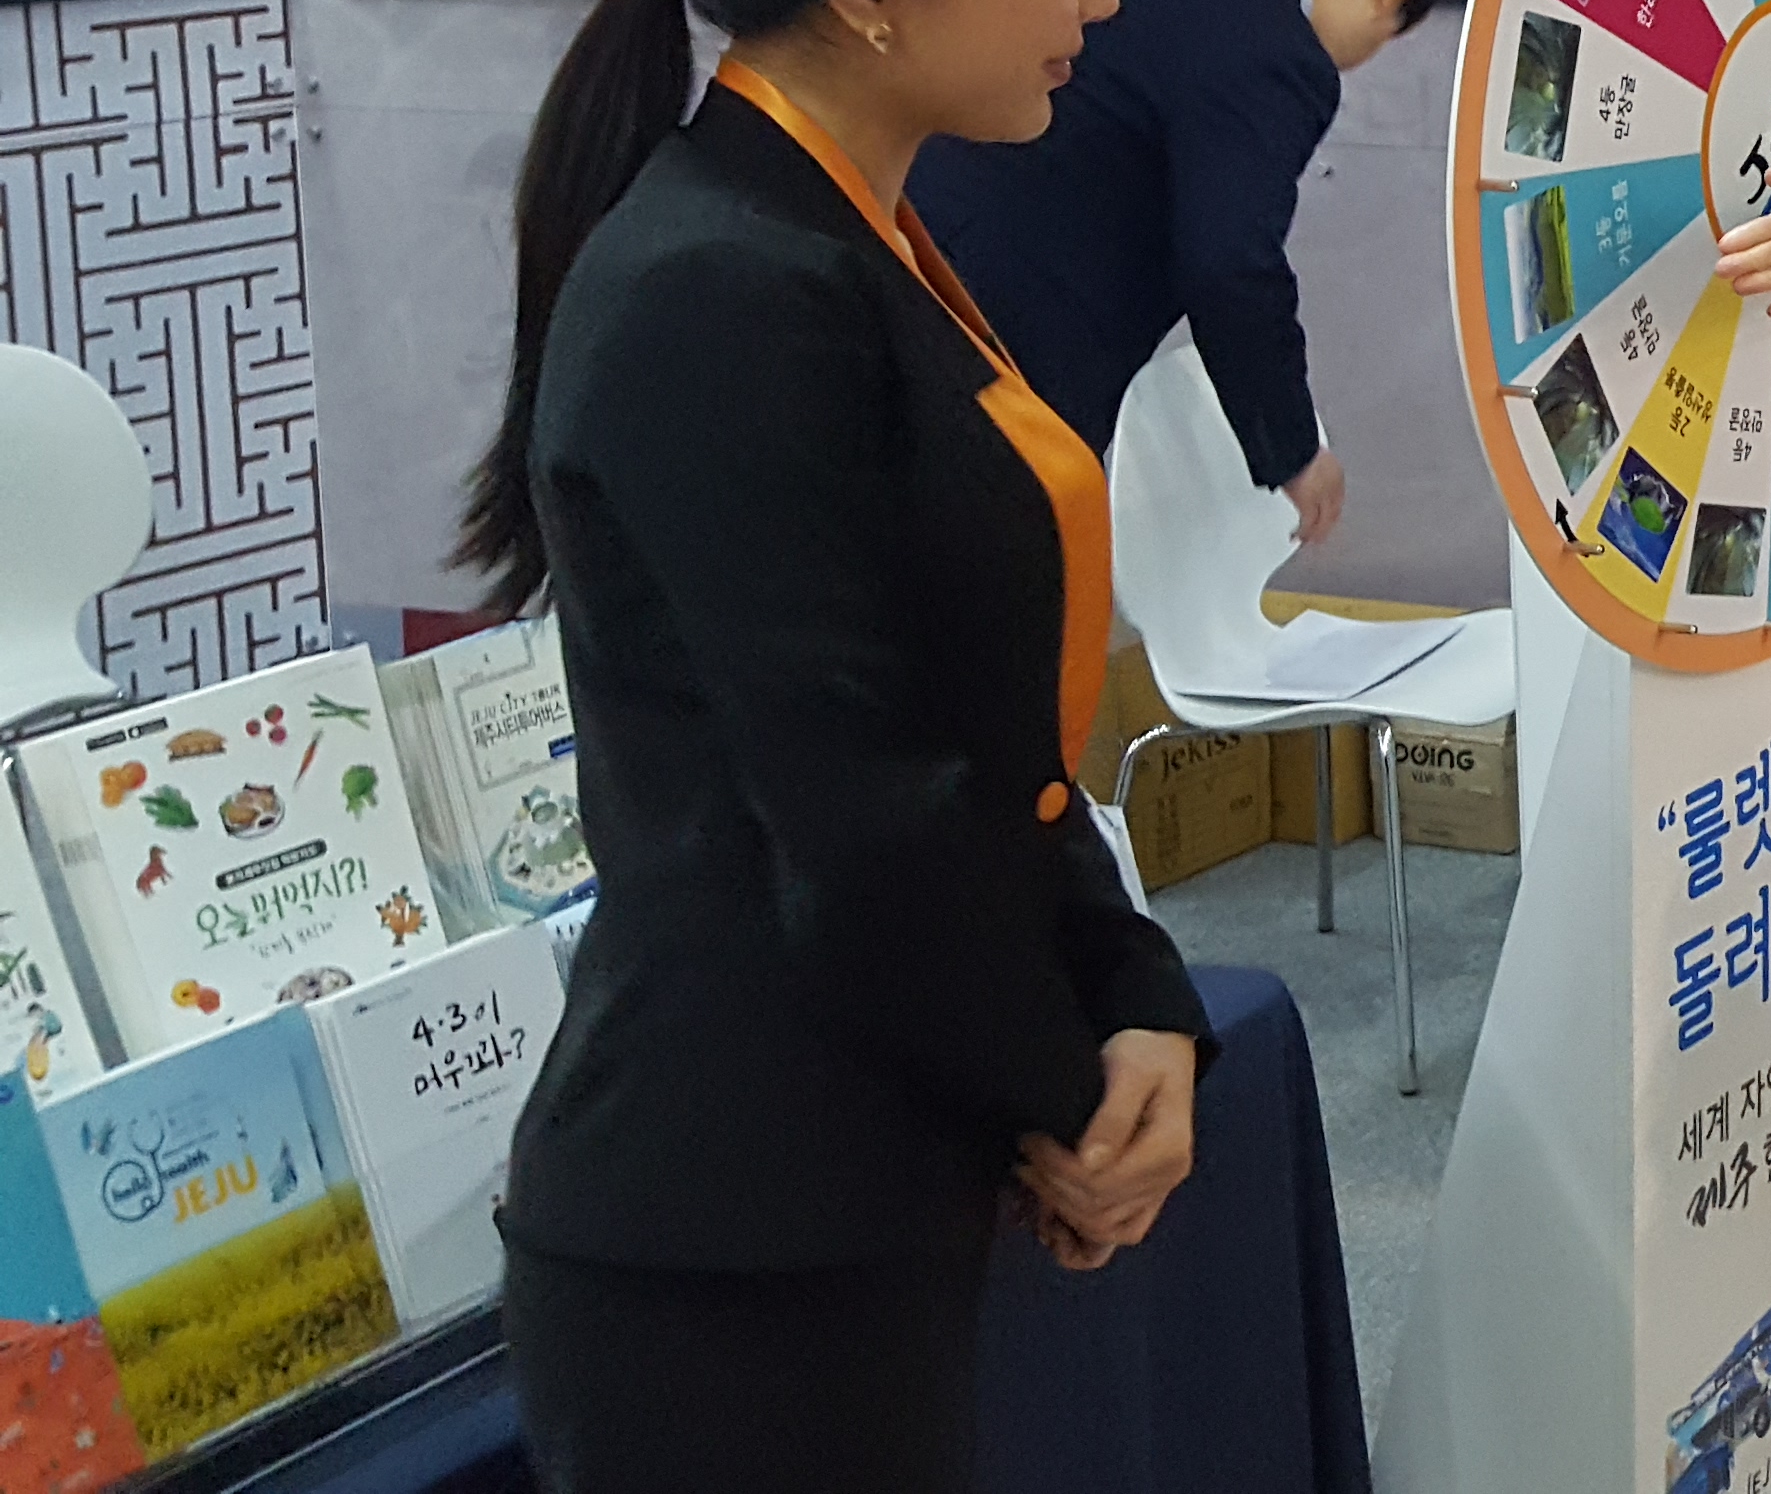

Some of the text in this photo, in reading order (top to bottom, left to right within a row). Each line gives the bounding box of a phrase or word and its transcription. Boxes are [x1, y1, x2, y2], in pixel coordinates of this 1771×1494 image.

[1599, 85, 1616, 123] 4등
[1612, 72, 1636, 140] 만장굴
[1630, 293, 1661, 356] 만장굴
[1728, 406, 1763, 434] 만장굴
[1732, 437, 1753, 463] 4등
[1677, 1093, 1732, 1164] 세계
[172, 1153, 258, 1224] JEJU
[1686, 1138, 1761, 1229] 제주
